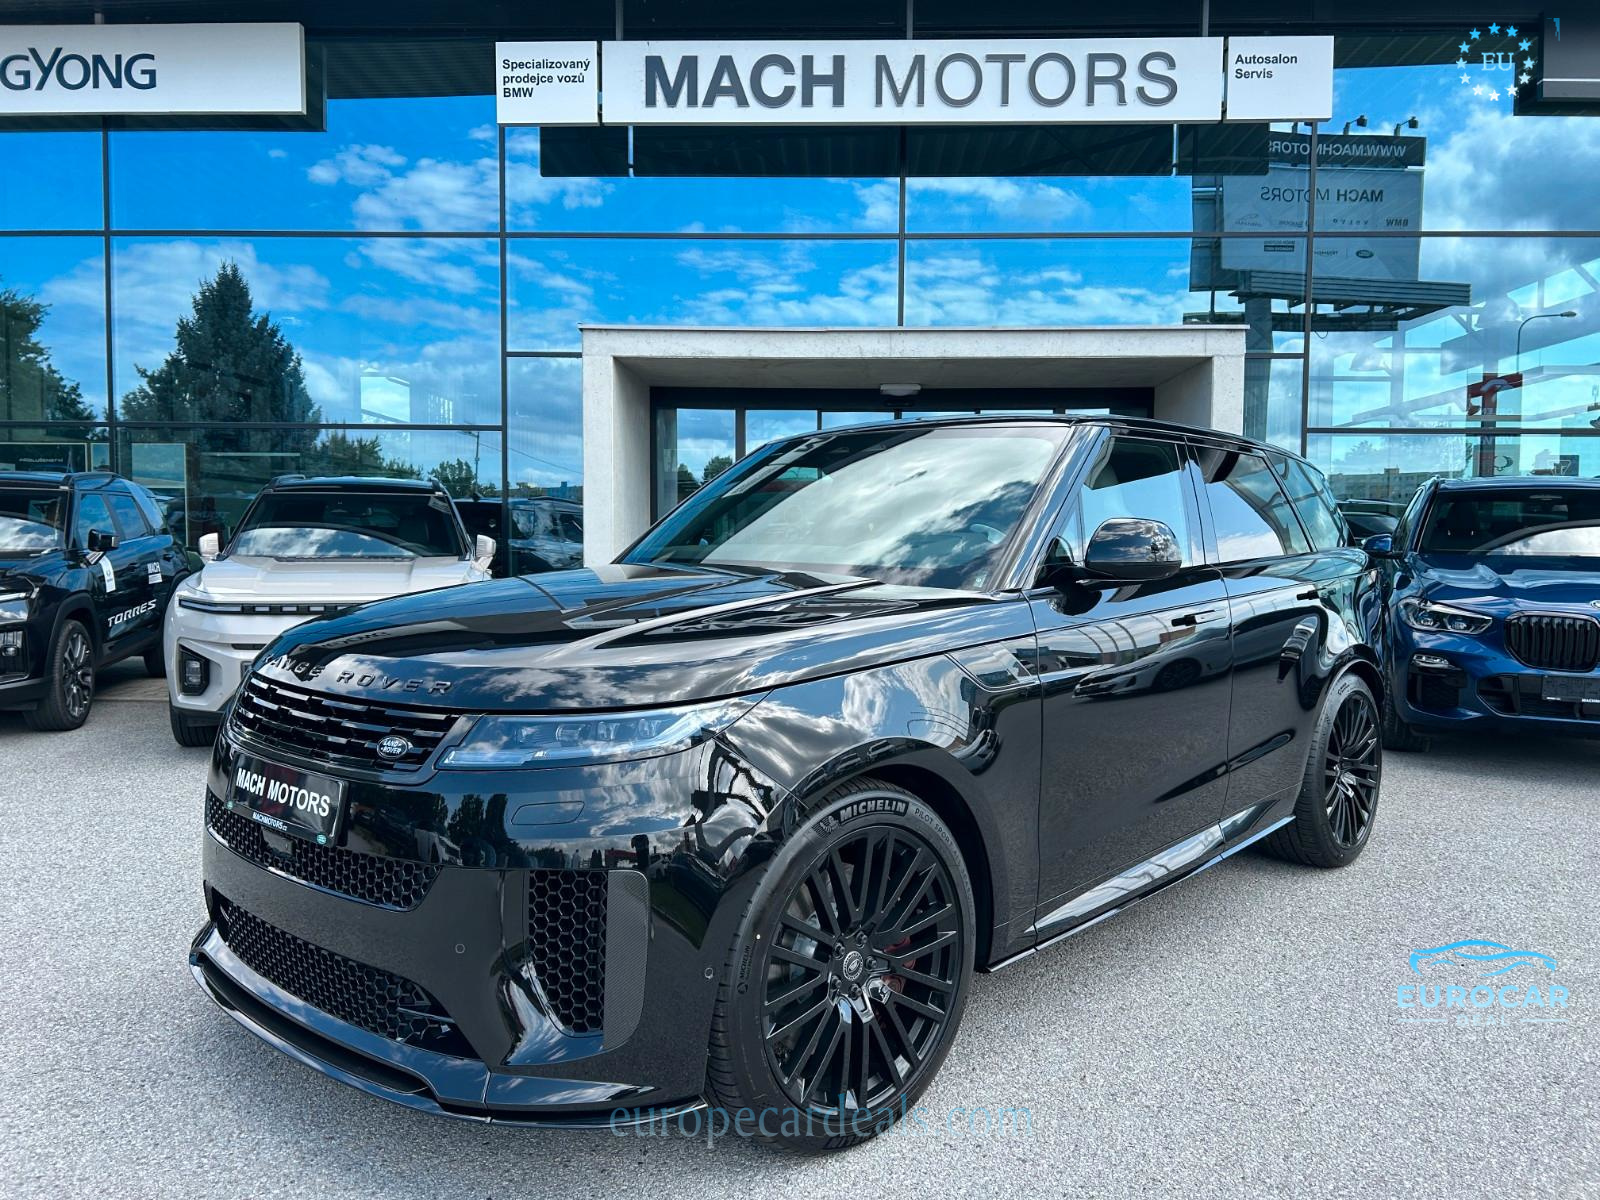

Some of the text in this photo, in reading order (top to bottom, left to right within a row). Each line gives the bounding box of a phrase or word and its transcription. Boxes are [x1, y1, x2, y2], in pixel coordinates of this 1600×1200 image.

[0, 47, 157, 91] GYONG
[502, 58, 591, 72] Specializovaný
[1234, 53, 1298, 65] Autosalon
[502, 72, 585, 86] prodejce vozů
[644, 51, 1178, 108] MACH MOTORS
[1234, 68, 1273, 79] Servis
[503, 87, 534, 98] BMW
[107, 598, 157, 628] TORRES
[336, 672, 452, 695] ROVER
[235, 767, 331, 818] MACH MOTORS
[839, 799, 907, 822] MICHELIN
[914, 807, 935, 825] PILOT
